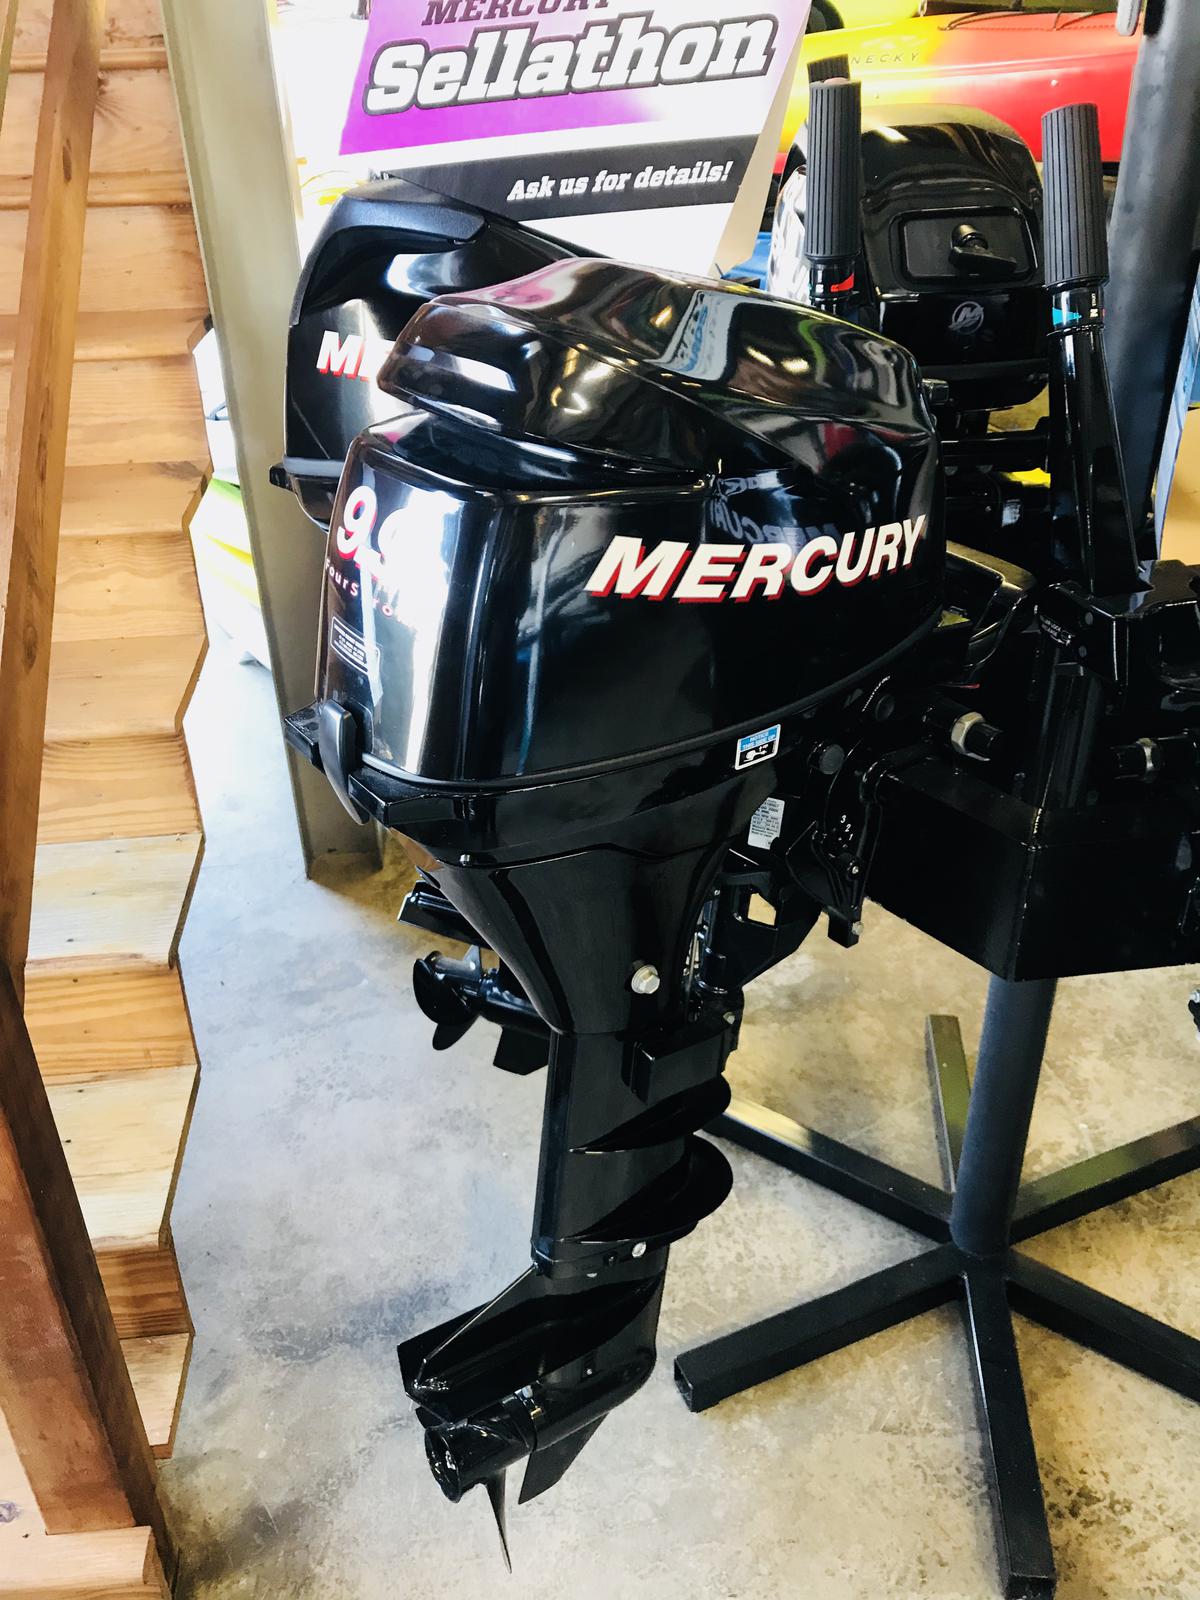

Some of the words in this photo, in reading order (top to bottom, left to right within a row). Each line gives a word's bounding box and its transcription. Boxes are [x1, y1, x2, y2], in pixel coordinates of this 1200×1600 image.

[362, 9, 779, 116] Sellathon
[850, 52, 919, 65] NECKY
[506, 175, 556, 201] Ask
[558, 176, 590, 196] us
[591, 169, 632, 193] for
[633, 160, 734, 189] details!
[583, 514, 926, 604] MERCURY
[840, 814, 847, 824] 3
[844, 823, 851, 832] 2
